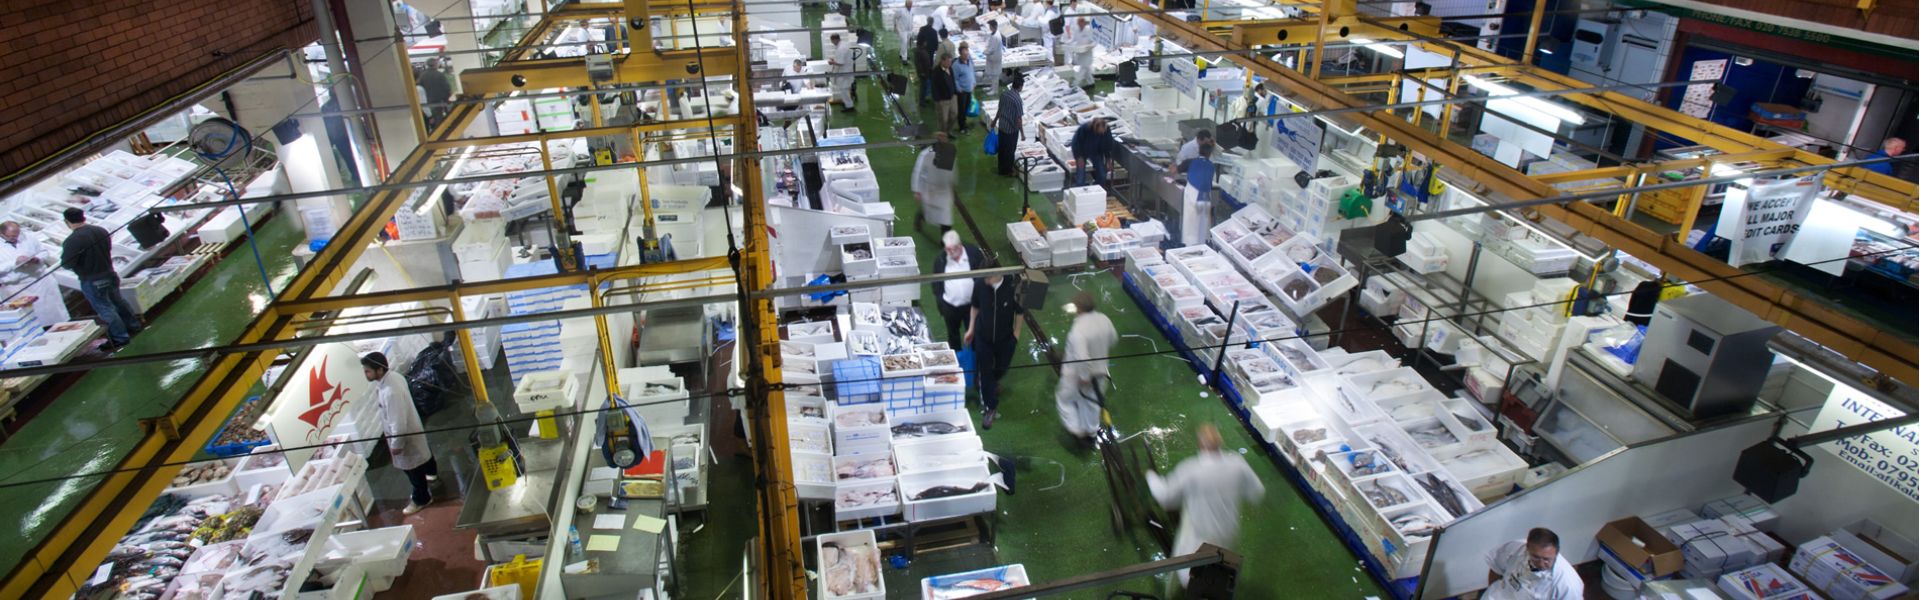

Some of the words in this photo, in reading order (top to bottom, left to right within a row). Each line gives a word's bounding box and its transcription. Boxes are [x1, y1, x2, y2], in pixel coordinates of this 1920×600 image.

[1691, 10, 1753, 28] PHONE/FAX
[1755, 22, 1775, 32] 020
[1761, 196, 1801, 210] ACCEPT
[1760, 210, 1795, 223] MAJOR
[1763, 223, 1801, 236] CARDS
[1835, 438, 1875, 463] Mob:
